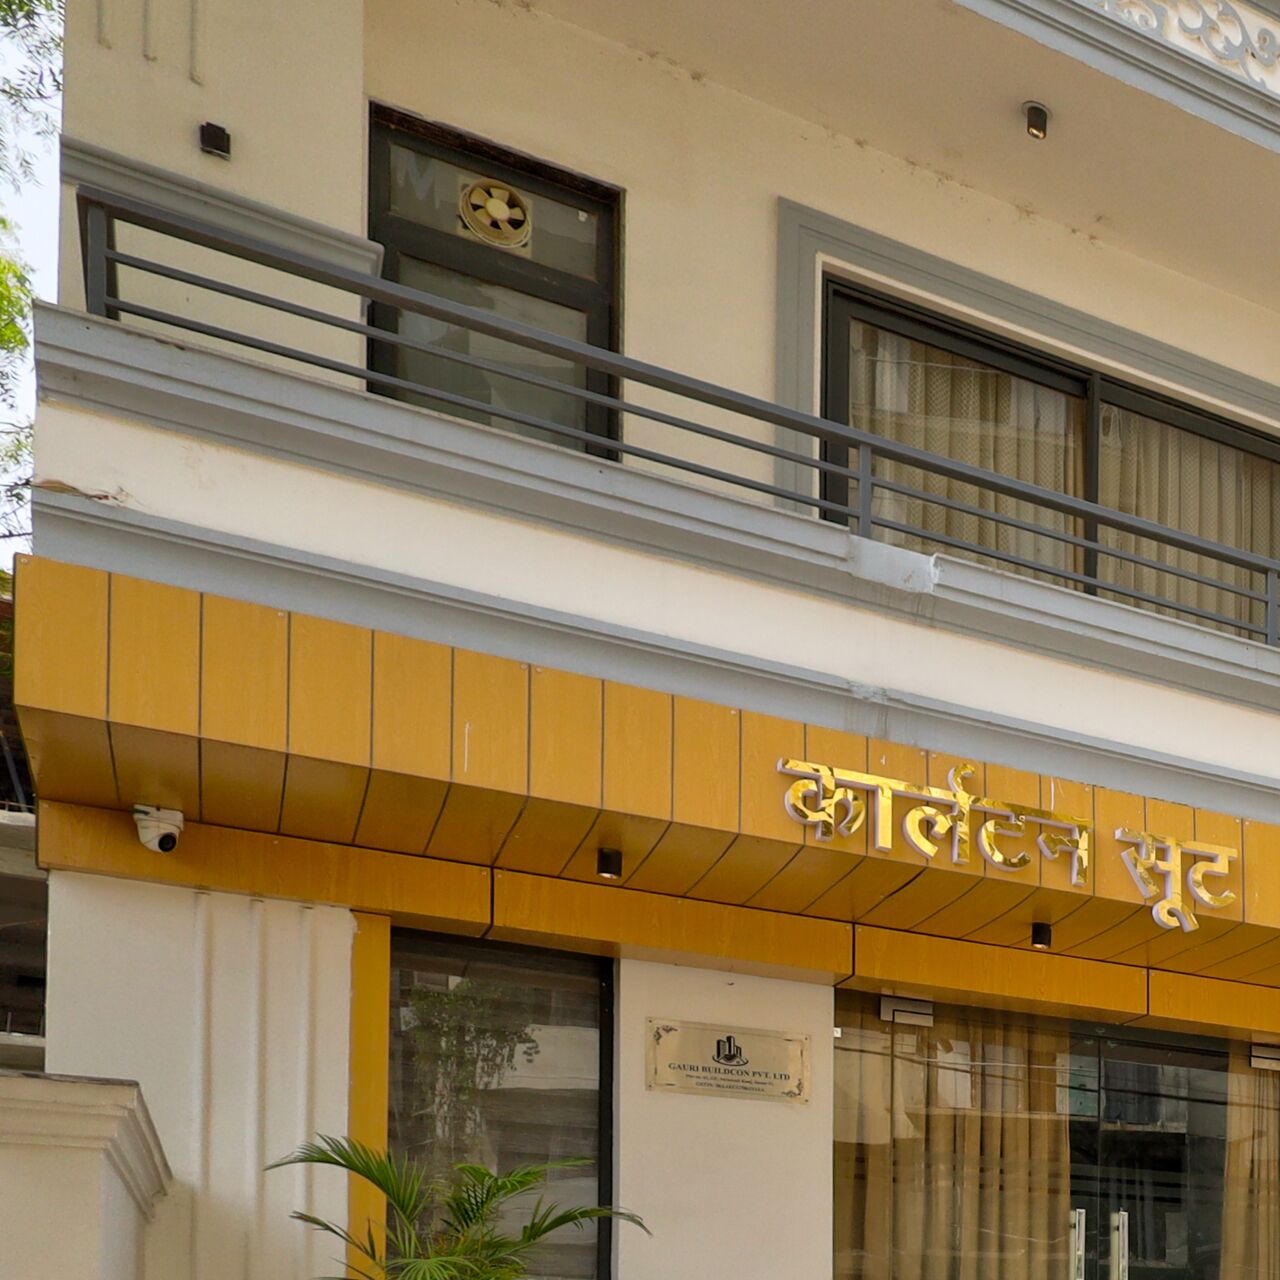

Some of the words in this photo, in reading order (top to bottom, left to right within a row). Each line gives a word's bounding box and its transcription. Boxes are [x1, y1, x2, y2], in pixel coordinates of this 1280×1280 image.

[777, 757, 1092, 887] कार्लटन
[1115, 827, 1239, 933] सूट
[668, 1062, 699, 1073] GAURI
[701, 1064, 750, 1077] BUILDCON
[773, 1072, 791, 1081] LTD
